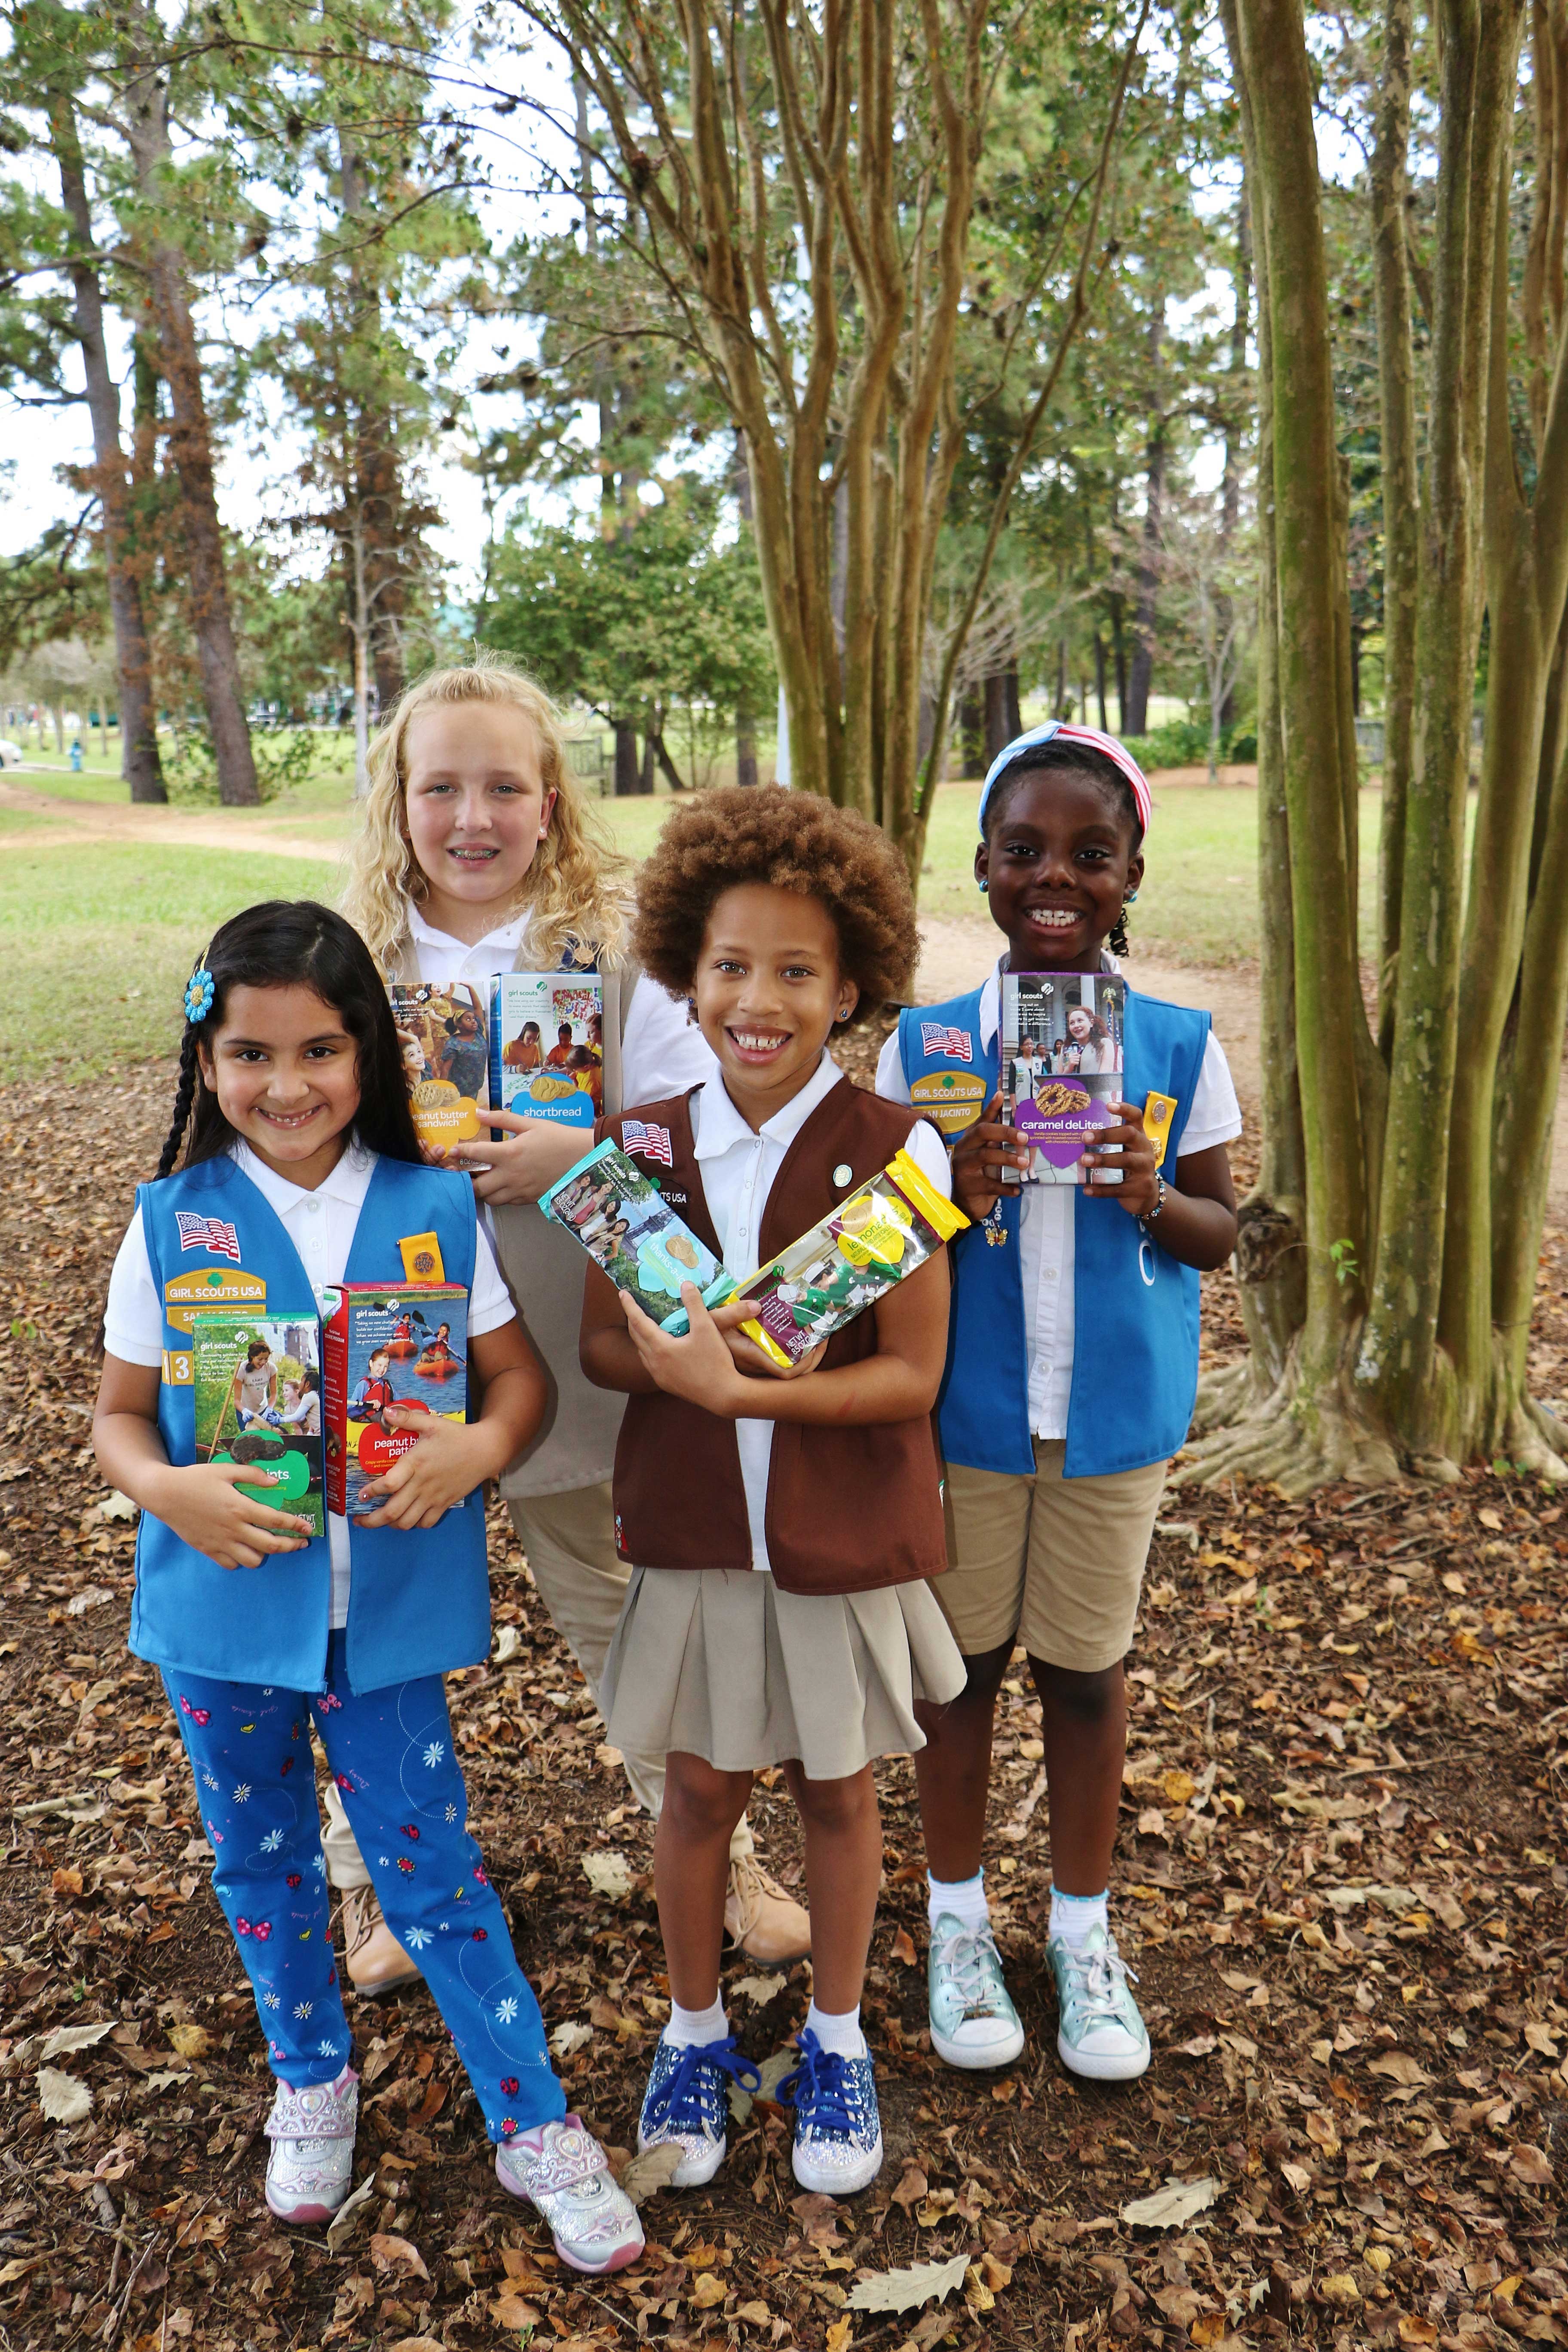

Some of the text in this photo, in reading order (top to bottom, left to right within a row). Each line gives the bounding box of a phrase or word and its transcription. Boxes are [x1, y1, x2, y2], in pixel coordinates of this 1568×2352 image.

[1011, 992, 1021, 1001] girl
[914, 1087, 982, 1098] GIRL SCOUTS USA
[440, 1111, 469, 1119] butter
[524, 1107, 581, 1117] shortbread
[940, 1108, 971, 1118] JACINTO
[418, 1119, 459, 1128] sandwich
[1021, 1120, 1064, 1130] caramel
[605, 1156, 627, 1179] girl scouts
[560, 1191, 576, 1208] NET WT
[672, 1192, 687, 1204] USA
[650, 1243, 686, 1285] thanks-a-lo
[169, 1286, 263, 1298] GIRL SCOUTS USA
[762, 1280, 781, 1296] scouts
[356, 1310, 367, 1319] girl
[785, 1329, 805, 1349] NET WT
[200, 1342, 213, 1351] girl
[374, 1438, 409, 1451] peanut
